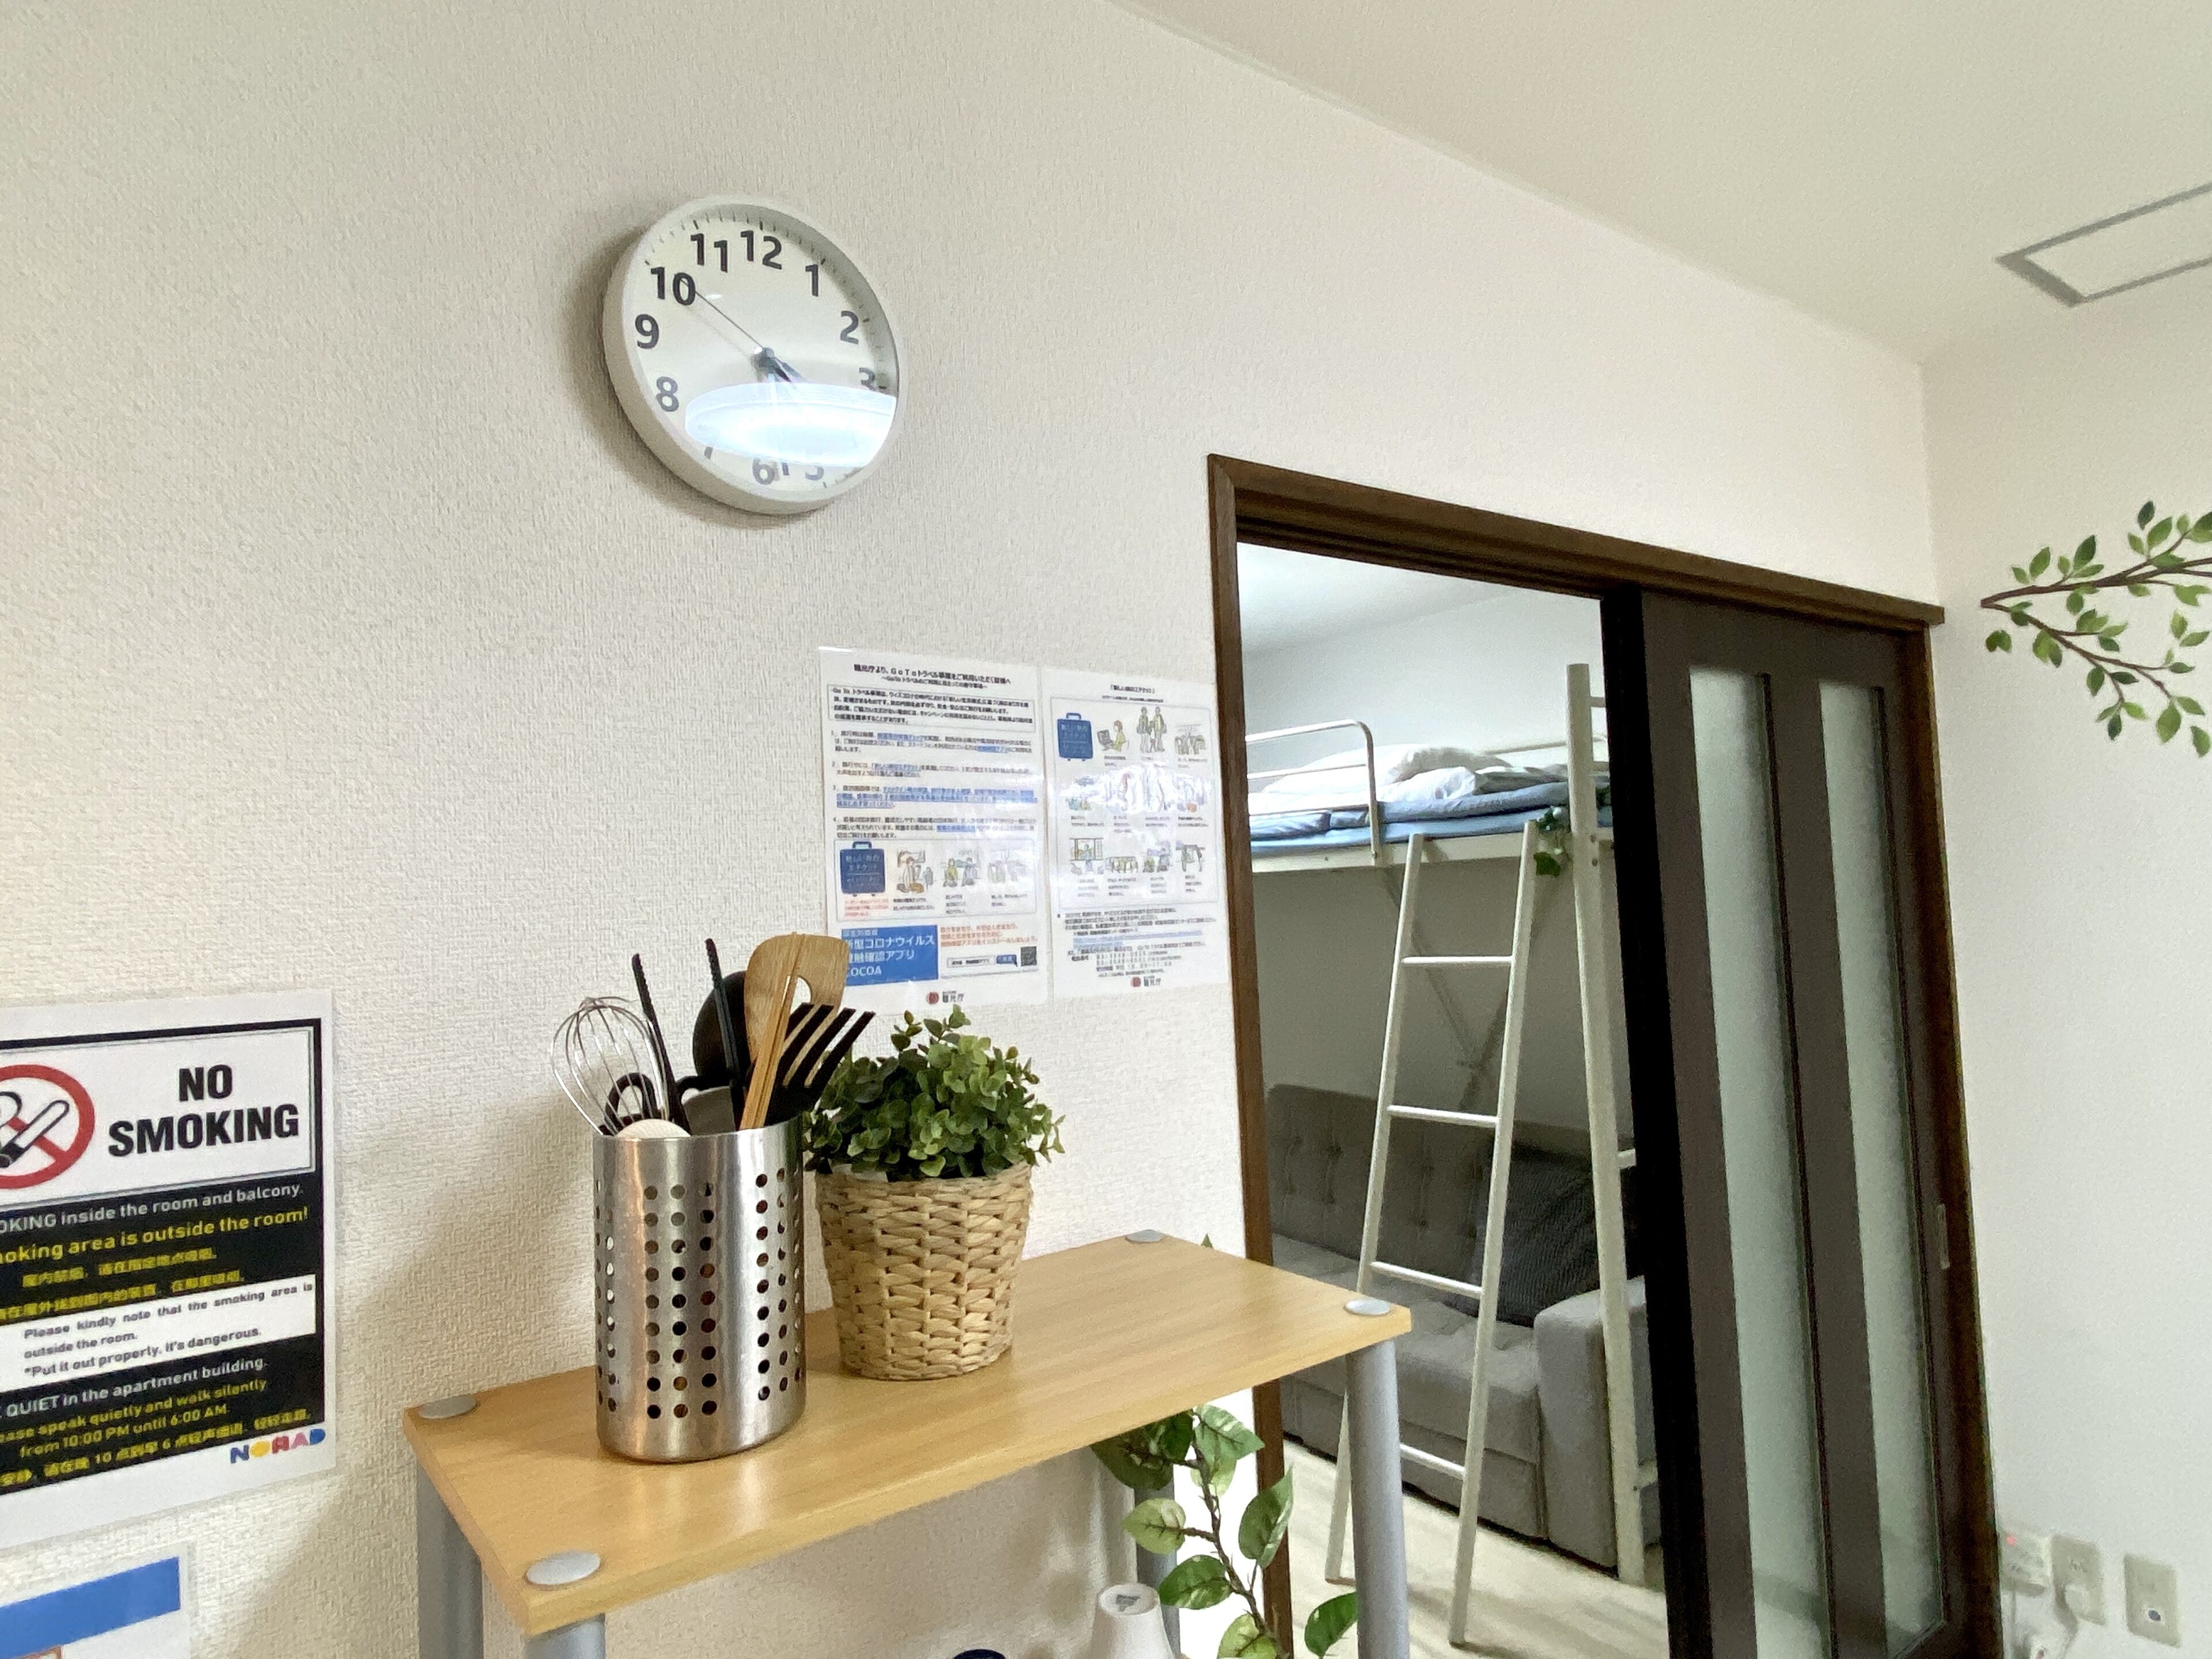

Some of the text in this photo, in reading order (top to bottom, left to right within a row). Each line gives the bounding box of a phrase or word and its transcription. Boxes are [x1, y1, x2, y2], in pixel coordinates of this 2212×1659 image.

[691, 233, 728, 272] 11
[740, 230, 782, 270] 12
[650, 266, 695, 306] 10
[805, 264, 819, 297] 1
[635, 313, 659, 349] 9
[840, 310, 859, 344] 2
[656, 376, 679, 412] 8
[847, 965, 882, 977] OCOA
[179, 1064, 232, 1102] NO
[108, 1103, 298, 1157] SMOKING
[61, 1207, 116, 1225] inside
[120, 1203, 147, 1217] the
[153, 1197, 198, 1213] room
[202, 1191, 232, 1206] and
[69, 1237, 115, 1254] area
[120, 1232, 138, 1246] is
[142, 1220, 215, 1243] outside
[219, 1217, 249, 1232] the
[253, 1206, 309, 1227] room!
[24, 1282, 312, 1339] Please kindly note that the smoking area is
[24, 1332, 138, 1359] outside the room.
[59, 1362, 69, 1372] it
[73, 1357, 95, 1370] out
[187, 1328, 262, 1349] dangerous.
[6, 1395, 60, 1417] QUIET
[63, 1394, 78, 1406] in
[82, 1389, 109, 1403] the
[112, 1369, 198, 1397] apartment
[37, 1415, 86, 1435] speak
[89, 1404, 142, 1426] quietly
[145, 1397, 172, 1414] and
[214, 1378, 267, 1399] silently
[20, 1442, 59, 1458] from
[63, 1430, 102, 1448] 10:00
[106, 1426, 130, 1440] PM
[133, 1416, 166, 1434] until
[170, 1408, 200, 1426] 6:00
